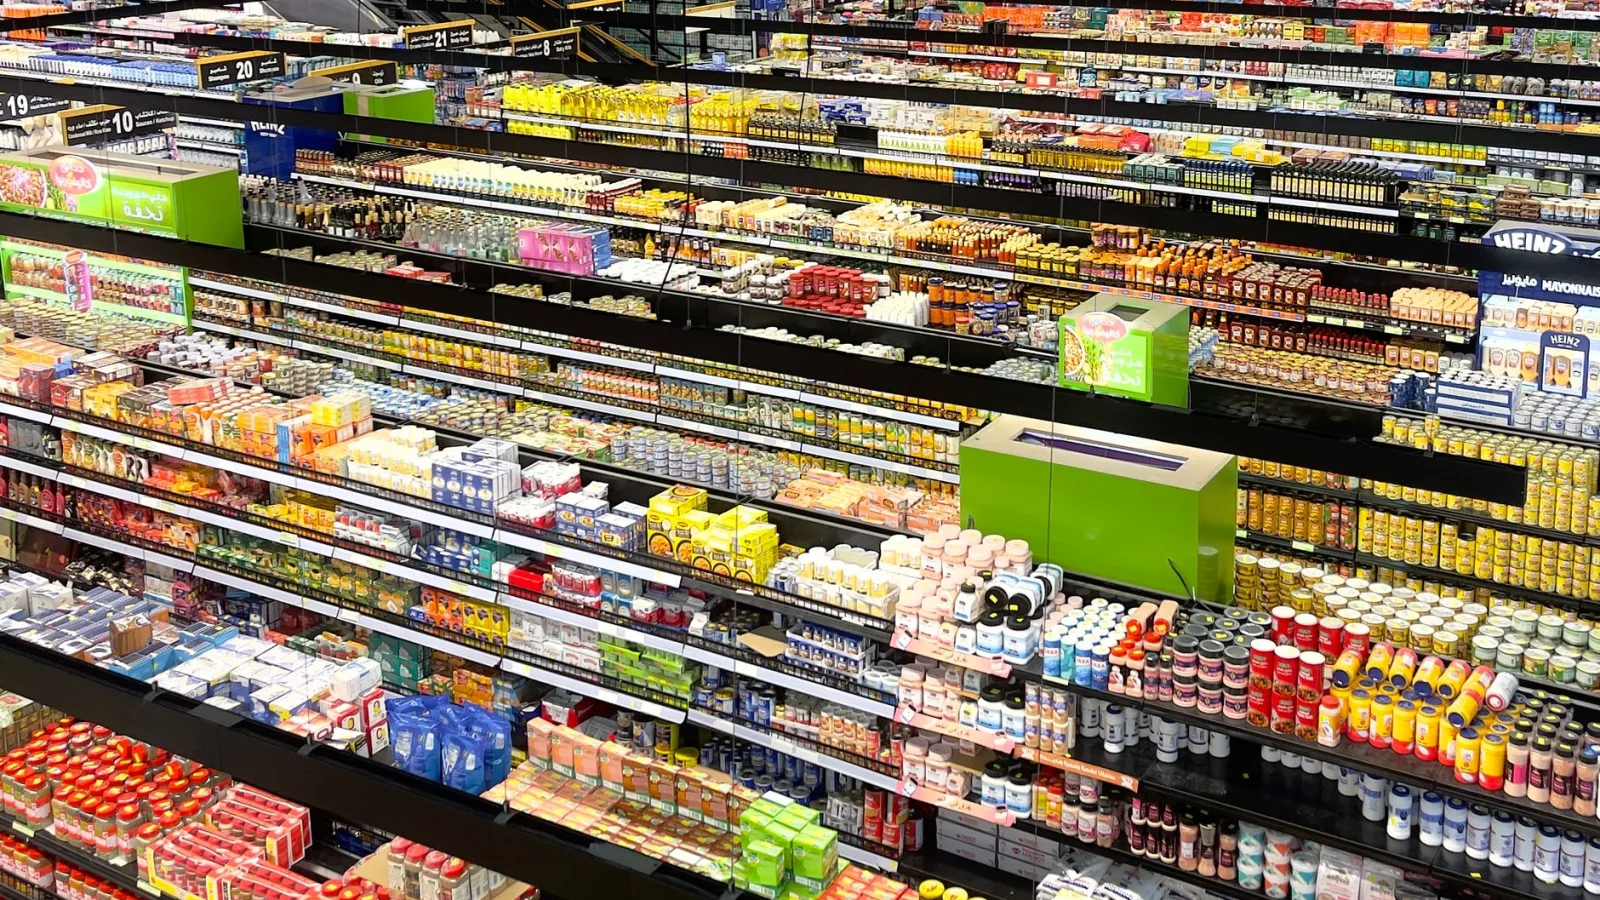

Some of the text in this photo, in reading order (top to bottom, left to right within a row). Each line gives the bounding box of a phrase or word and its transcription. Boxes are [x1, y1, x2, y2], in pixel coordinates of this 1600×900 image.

[434, 30, 447, 48] 21
[543, 39, 551, 57] 8
[235, 60, 254, 80] 20
[7, 94, 28, 116] 19
[112, 110, 134, 134] 10
[1494, 232, 1566, 254] HEINZ
[1550, 335, 1580, 346] HEINZ
